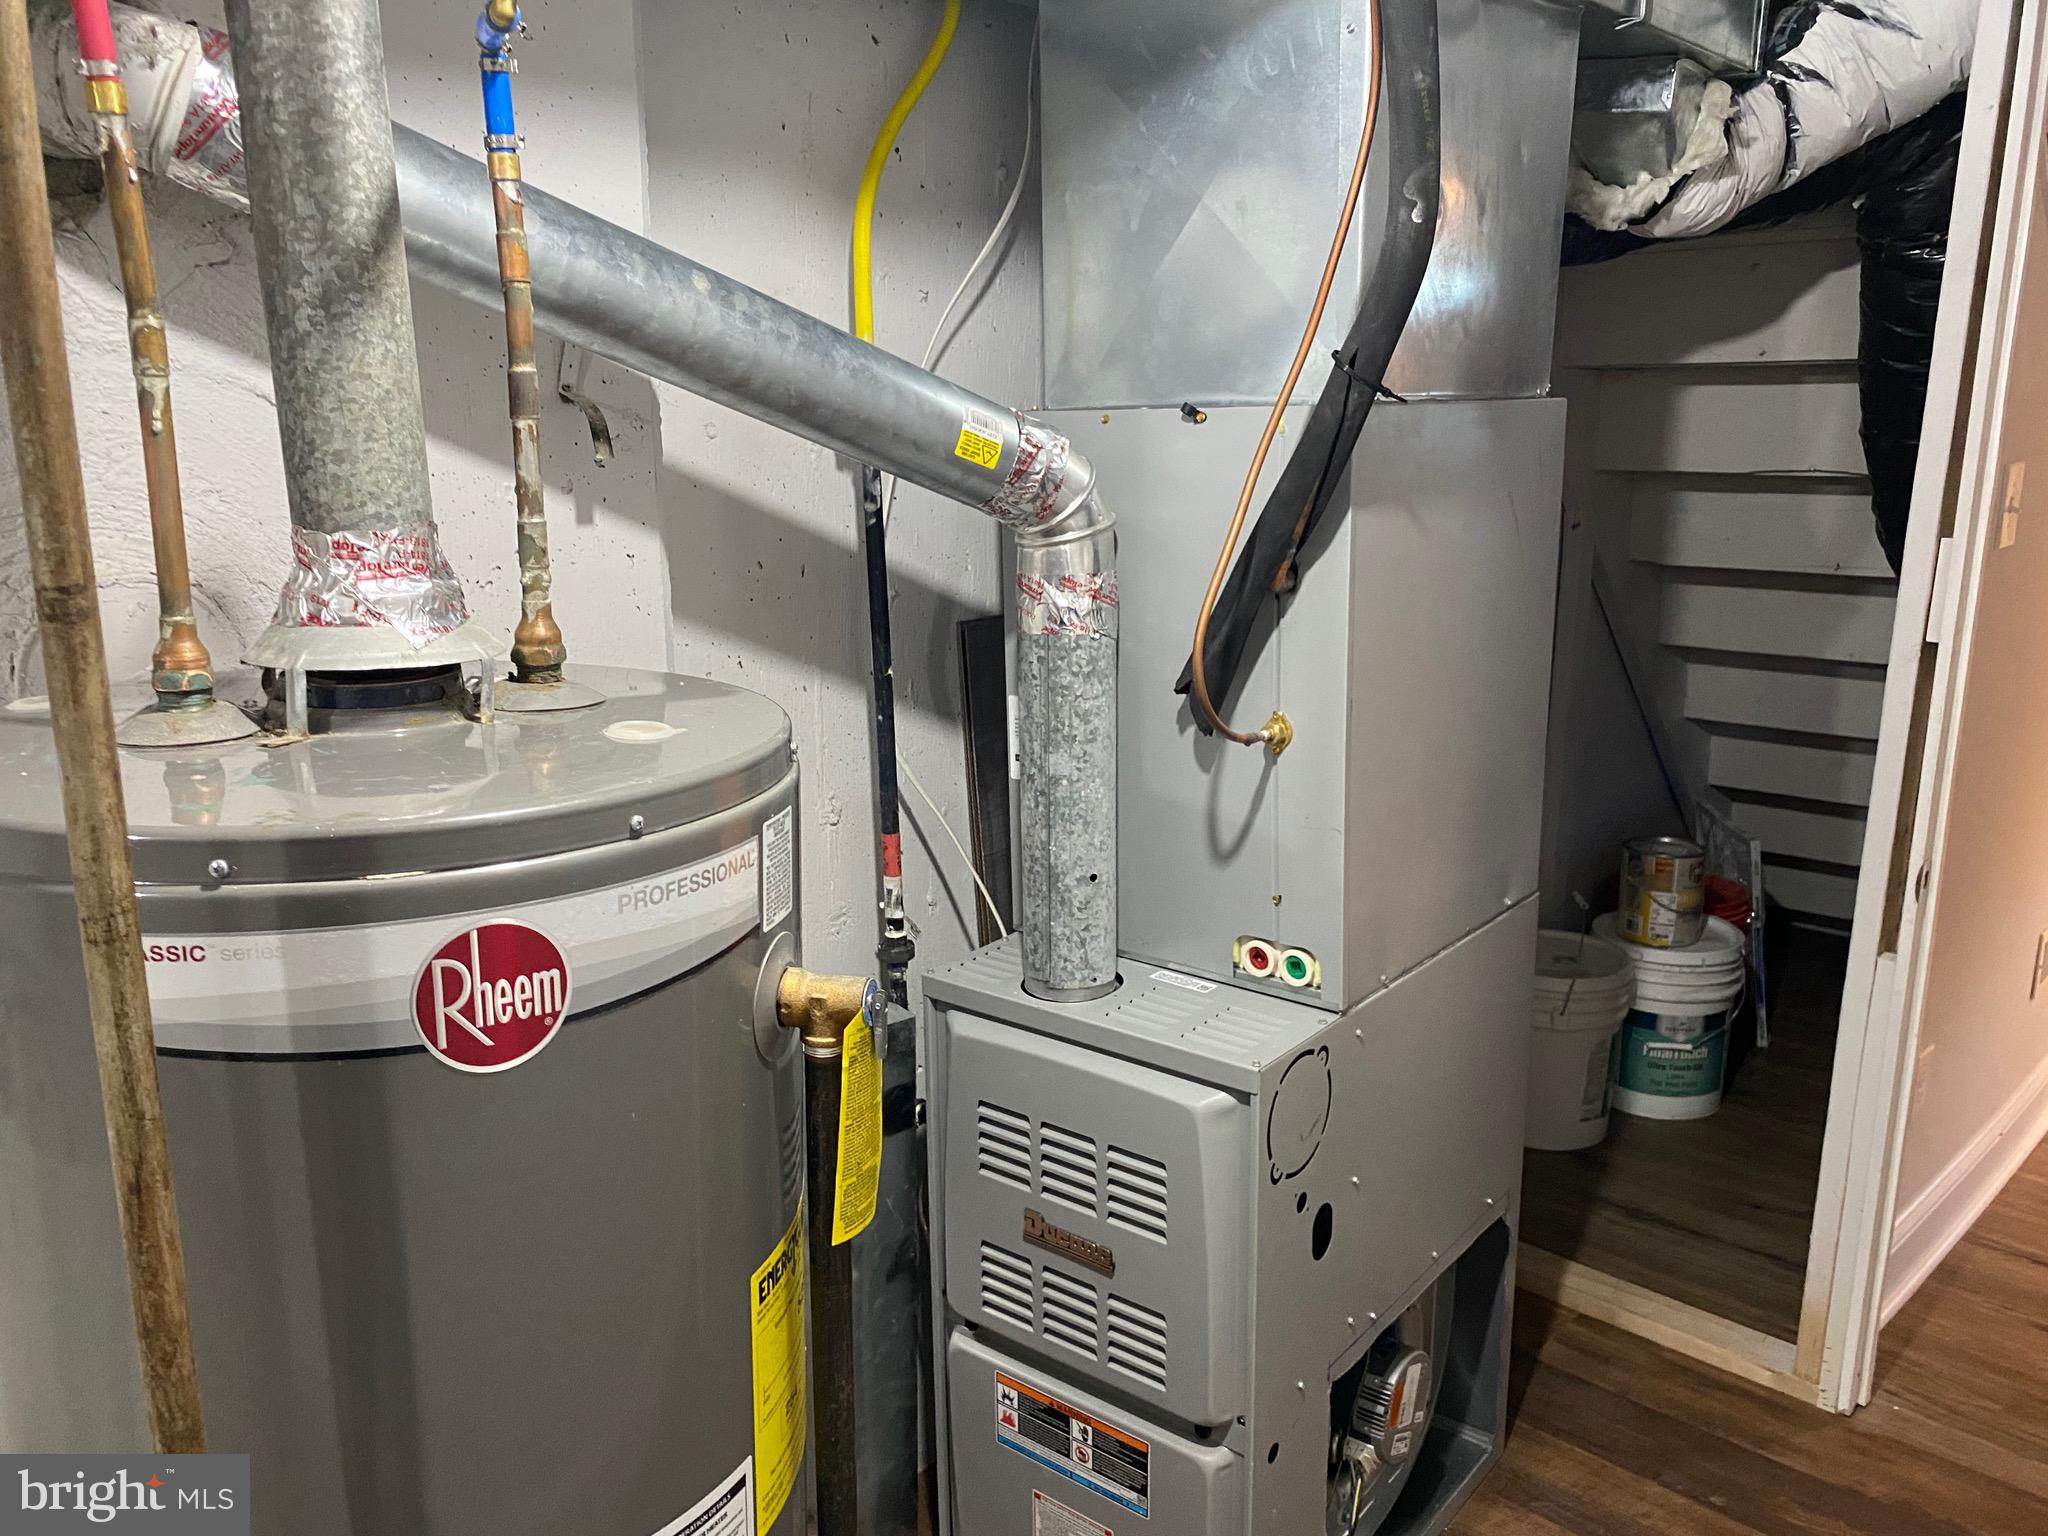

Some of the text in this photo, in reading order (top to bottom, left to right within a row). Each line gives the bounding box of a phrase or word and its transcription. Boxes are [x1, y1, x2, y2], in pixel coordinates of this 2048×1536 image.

[618, 851, 756, 914] PROFESSIONAL
[220, 945, 286, 962] series
[432, 929, 562, 1050] Rheem
